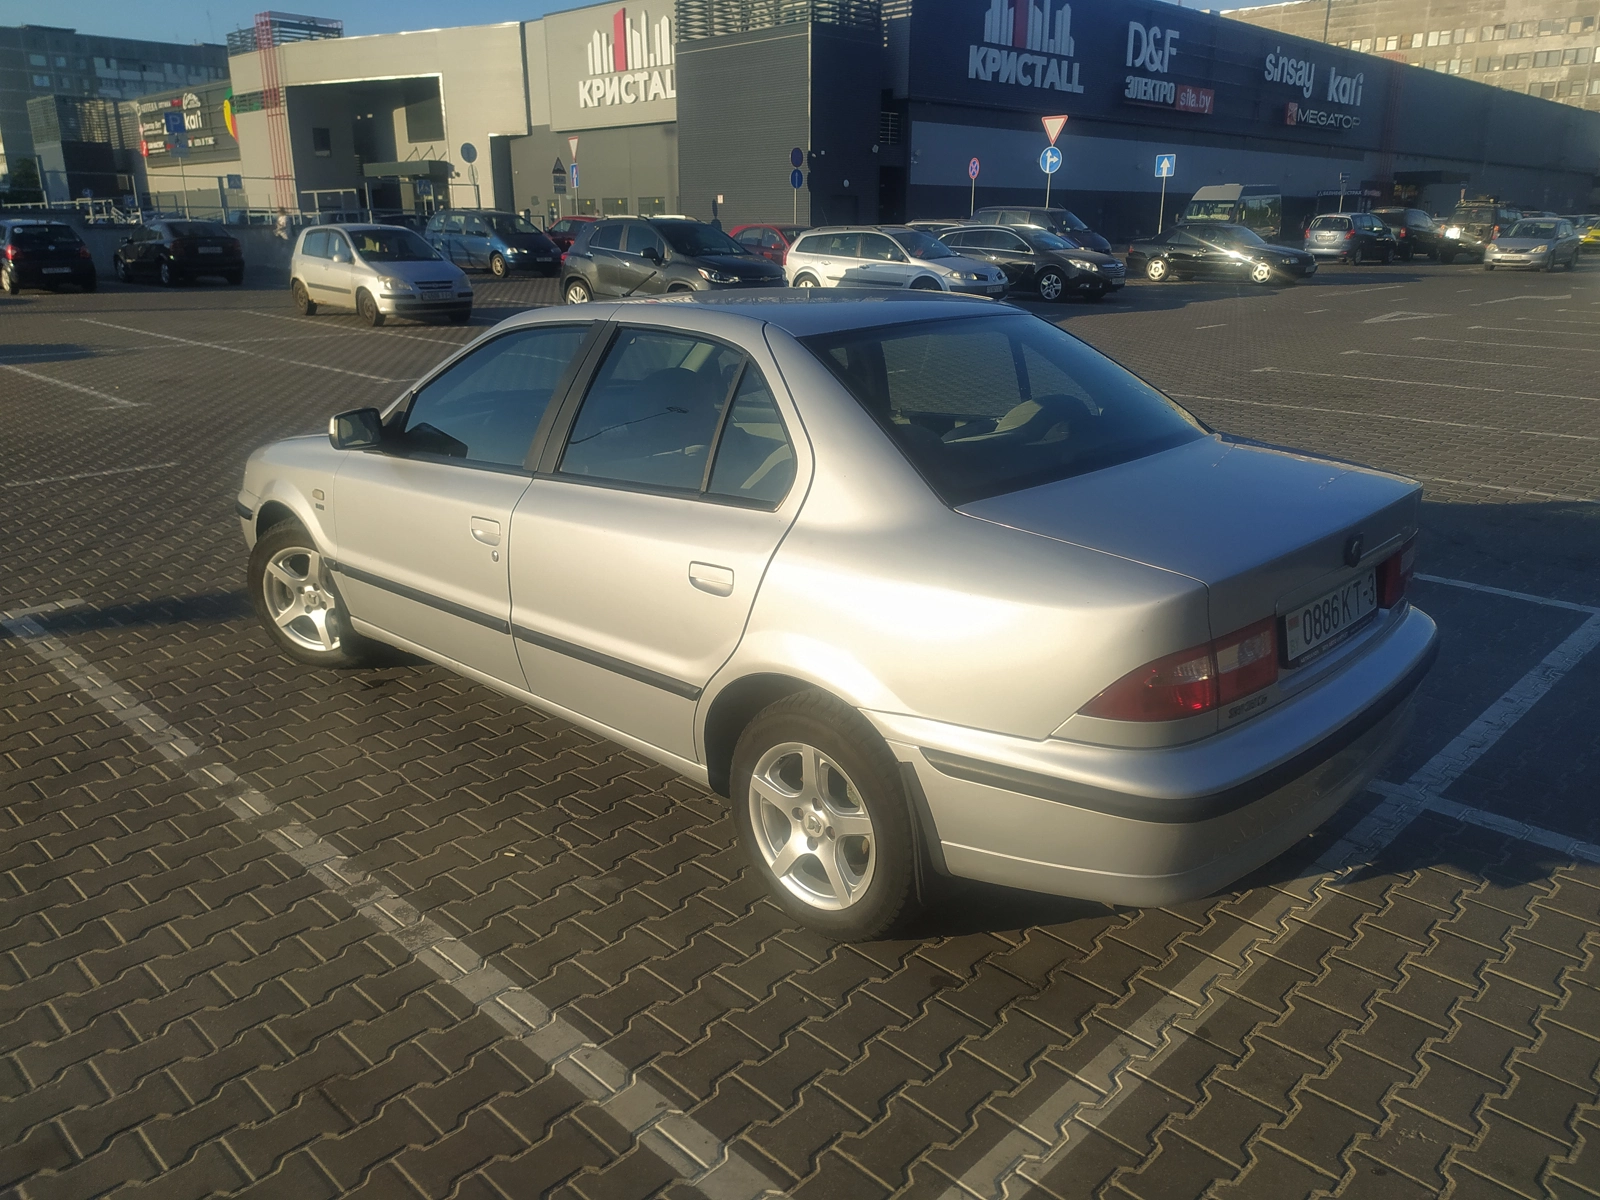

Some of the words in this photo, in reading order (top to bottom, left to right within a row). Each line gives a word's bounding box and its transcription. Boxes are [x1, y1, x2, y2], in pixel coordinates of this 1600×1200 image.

[1125, 21, 1180, 73] D&F
[1264, 46, 1315, 98] sinsay
[1327, 67, 1364, 106] kari
[1124, 75, 1176, 104] ЭЛЕКТРО
[1180, 89, 1212, 114] sila.by
[1297, 108, 1361, 128] MEGATOP
